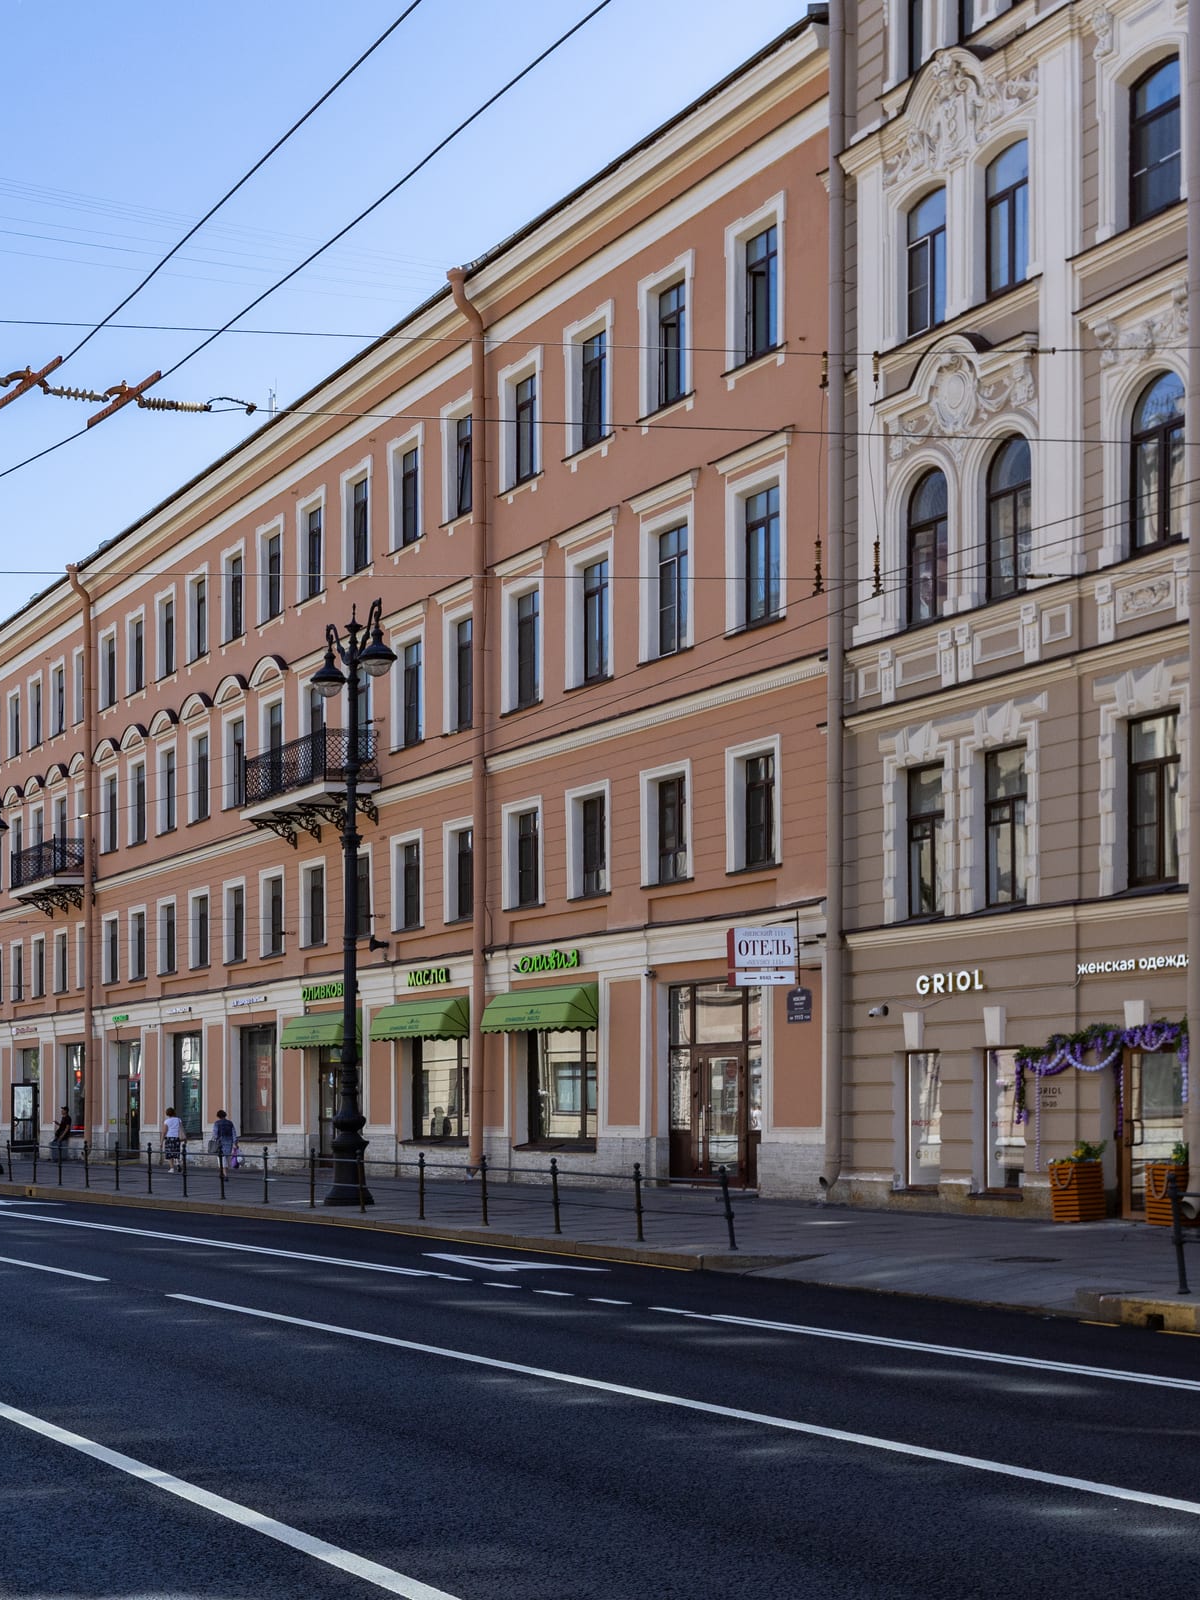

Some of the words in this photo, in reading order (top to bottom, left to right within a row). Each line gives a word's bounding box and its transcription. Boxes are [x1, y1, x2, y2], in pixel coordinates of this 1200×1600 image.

[738, 939, 791, 956] ОТЕЛЬ
[1077, 960, 1135, 976] женская
[916, 968, 984, 995] GRIOL
